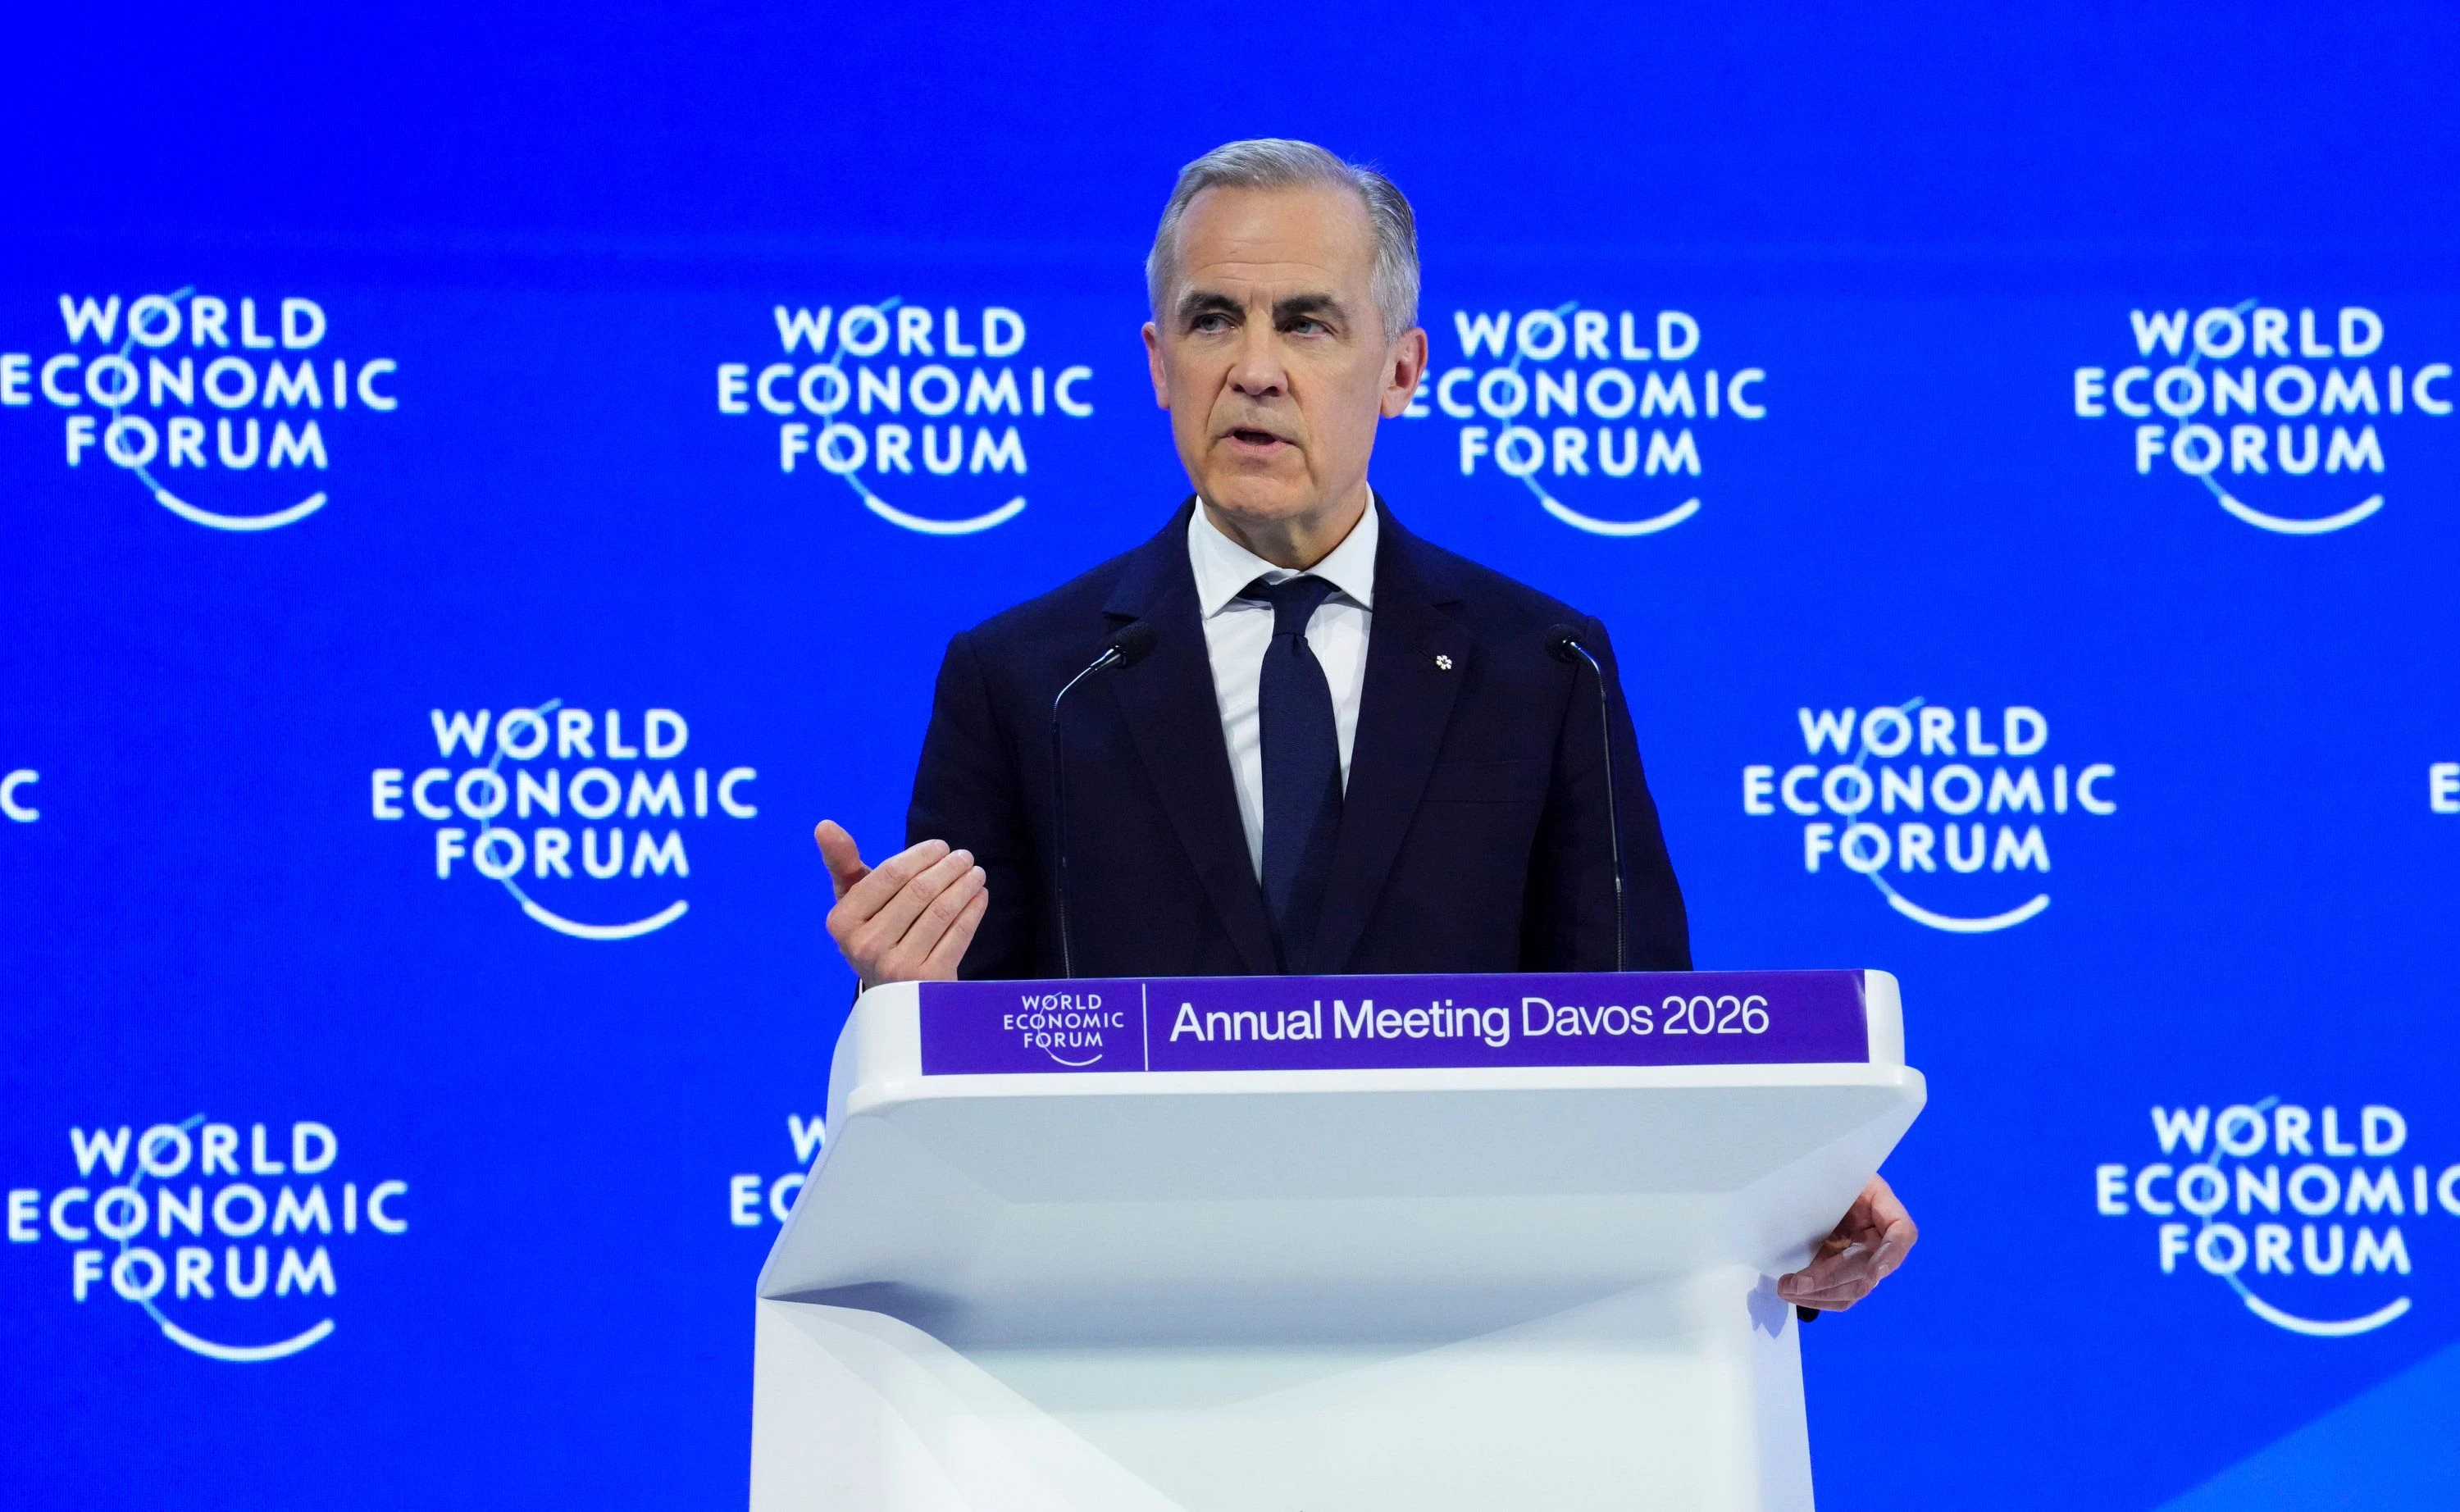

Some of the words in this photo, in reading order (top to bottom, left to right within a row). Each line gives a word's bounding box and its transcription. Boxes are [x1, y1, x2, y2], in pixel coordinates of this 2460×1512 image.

[59, 293, 326, 349] WORLD
[773, 304, 1026, 358] WORLD
[1453, 308, 1702, 361] WORLD
[2130, 306, 2385, 359] WORLD
[0, 353, 398, 412] ECONOMIC
[716, 362, 1093, 418] ECONOMIC
[2073, 362, 2453, 418] ECONOMIC
[65, 415, 328, 470] FORUM
[779, 421, 1027, 476] FORUM
[1459, 425, 1702, 479] FORUM
[2134, 423, 2385, 477] FORUM
[430, 706, 689, 761] WORLD
[1797, 704, 2048, 758] WORLD
[371, 764, 758, 822] ECONOMIC
[1742, 763, 2118, 817] ECONOMIC
[435, 826, 690, 883] FORUM
[1802, 821, 2052, 877] FORUM
[1003, 1011, 1124, 1031] ECONOMIC
[1021, 993, 1102, 1012] WORLD
[1169, 999, 1322, 1042] Annual
[1333, 999, 1510, 1049] Meeting
[1522, 997, 1654, 1037] Davos
[1662, 995, 1770, 1035] 2026
[1023, 1031, 1103, 1049] FORUM
[70, 1120, 339, 1179] WORLD
[2150, 1104, 2408, 1157] WORLD
[8, 1179, 408, 1244] ECONOMIC
[2095, 1162, 2460, 1218] ECONOMIC
[72, 1245, 337, 1304] FORUM
[2158, 1222, 2412, 1277] FORUM
